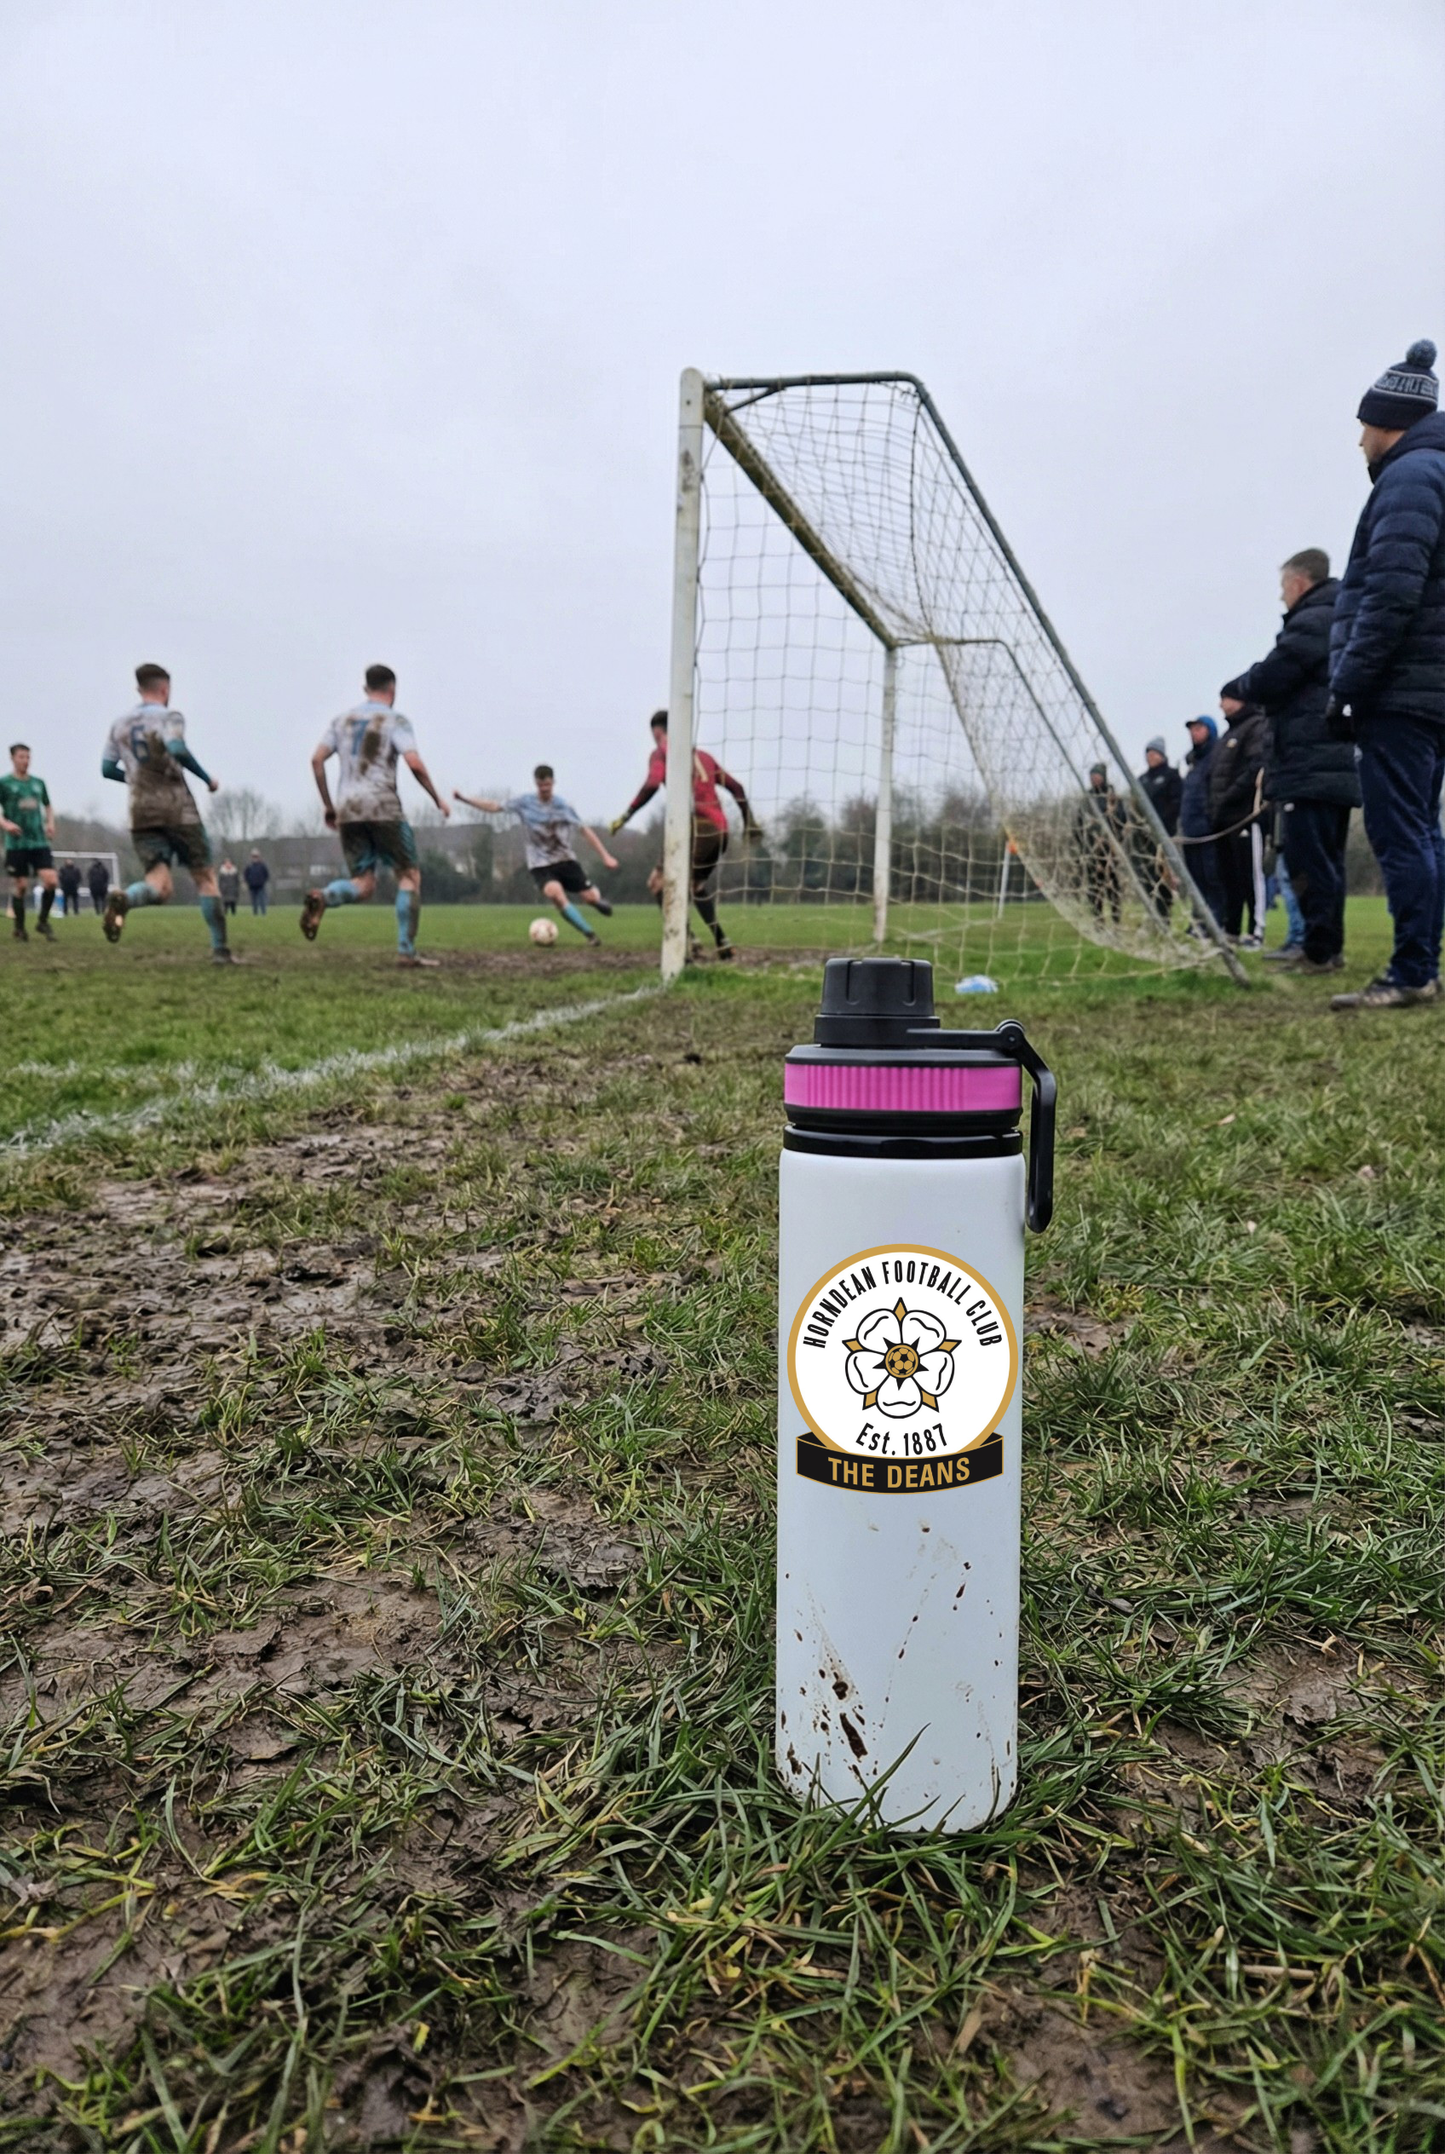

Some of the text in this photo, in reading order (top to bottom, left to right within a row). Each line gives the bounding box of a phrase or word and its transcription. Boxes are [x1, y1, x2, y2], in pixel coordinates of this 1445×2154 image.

[129, 724, 151, 764] 6
[350, 719, 370, 755] 7
[803, 1260, 1003, 1348] HORNDEAN FOOTBALL CLUB
[855, 1422, 947, 1456] Est. 1887
[827, 1456, 971, 1489] THE DEANS
